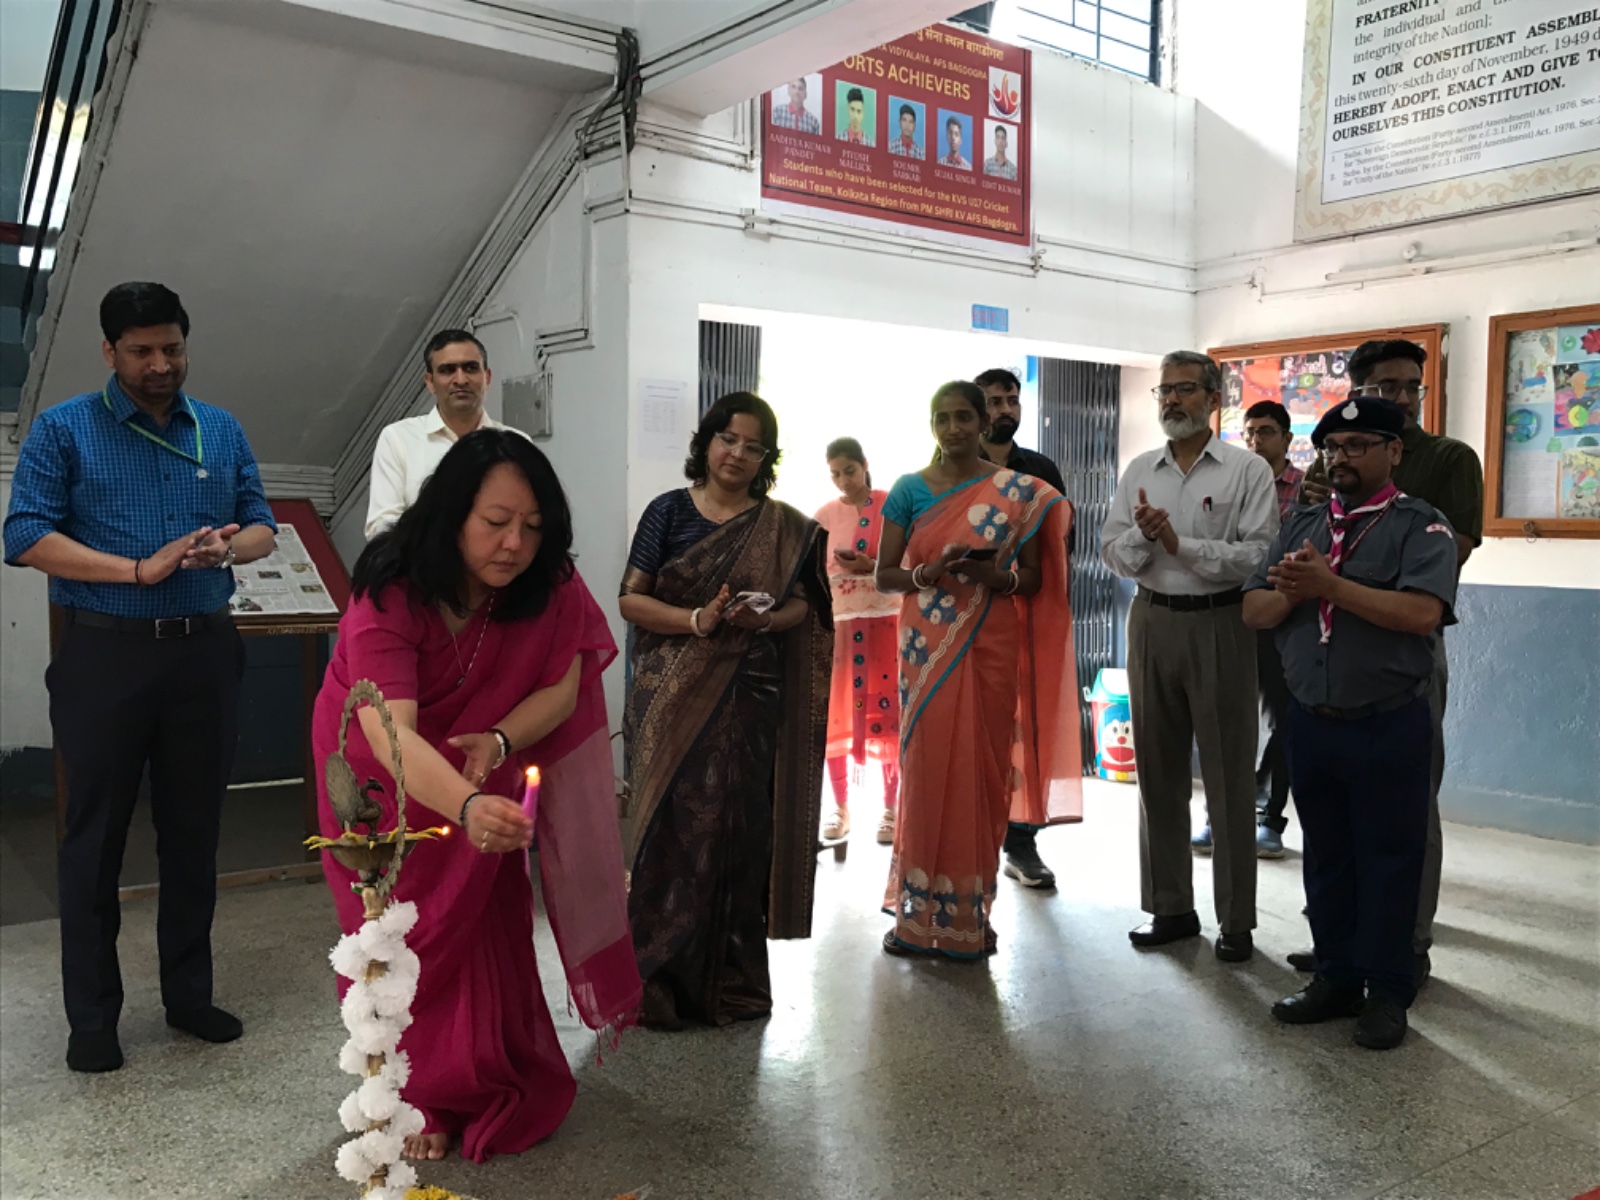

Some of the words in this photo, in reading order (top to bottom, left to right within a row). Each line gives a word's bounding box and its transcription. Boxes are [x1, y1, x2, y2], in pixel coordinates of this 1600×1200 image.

[925, 27, 943, 43] सेना
[1355, 0, 1439, 28] FRATERNIT
[1355, 33, 1373, 46] the
[1383, 8, 1445, 37] individual
[1456, 0, 1482, 16] and
[889, 44, 930, 64] VIDYALAYA
[933, 57, 947, 70] AFS
[947, 61, 988, 80] BAGDOGRA
[1334, 92, 1356, 108] this
[1358, 70, 1434, 100] twenty-sixth
[1436, 65, 1460, 83] day
[1461, 59, 1477, 74] of
[1554, 29, 1590, 50] 1949
[1593, 26, 1600, 40] d
[1352, 71, 1367, 86] IN
[1375, 61, 1404, 80] OUR
[1413, 30, 1516, 69] CONSTITUENT
[1525, 8, 1600, 39] ASSEMBL
[1353, 41, 1406, 64] integrity
[1405, 33, 1418, 48] of
[1418, 31, 1438, 45] the
[844, 54, 885, 78] ORTS
[887, 64, 972, 101] ACHIEVERS
[1333, 101, 1387, 125] HEREBY
[1446, 74, 1497, 97] ENACT
[1501, 64, 1535, 84] AND
[1540, 52, 1581, 73] GIVE
[1587, 48, 1600, 63] T
[1332, 114, 1414, 142] OURSELVES
[1412, 101, 1446, 124] THIS
[1447, 76, 1566, 114] CONSTITUTION.
[769, 172, 808, 191] National
[809, 180, 836, 197] Team,
[837, 186, 869, 203] Kolkata
[870, 193, 899, 208] Region
[899, 197, 919, 212] from
[920, 203, 933, 214] PM
[934, 206, 953, 219] SHRI
[955, 210, 966, 221] KV
[966, 212, 982, 224] AFS
[783, 158, 824, 175] Students
[825, 167, 843, 180] who
[844, 171, 866, 185] have
[866, 175, 888, 190] been
[888, 181, 923, 197] selected
[924, 187, 935, 199] for
[937, 191, 950, 202] the
[951, 193, 968, 206] KVS
[983, 200, 1010, 214] Cricket
